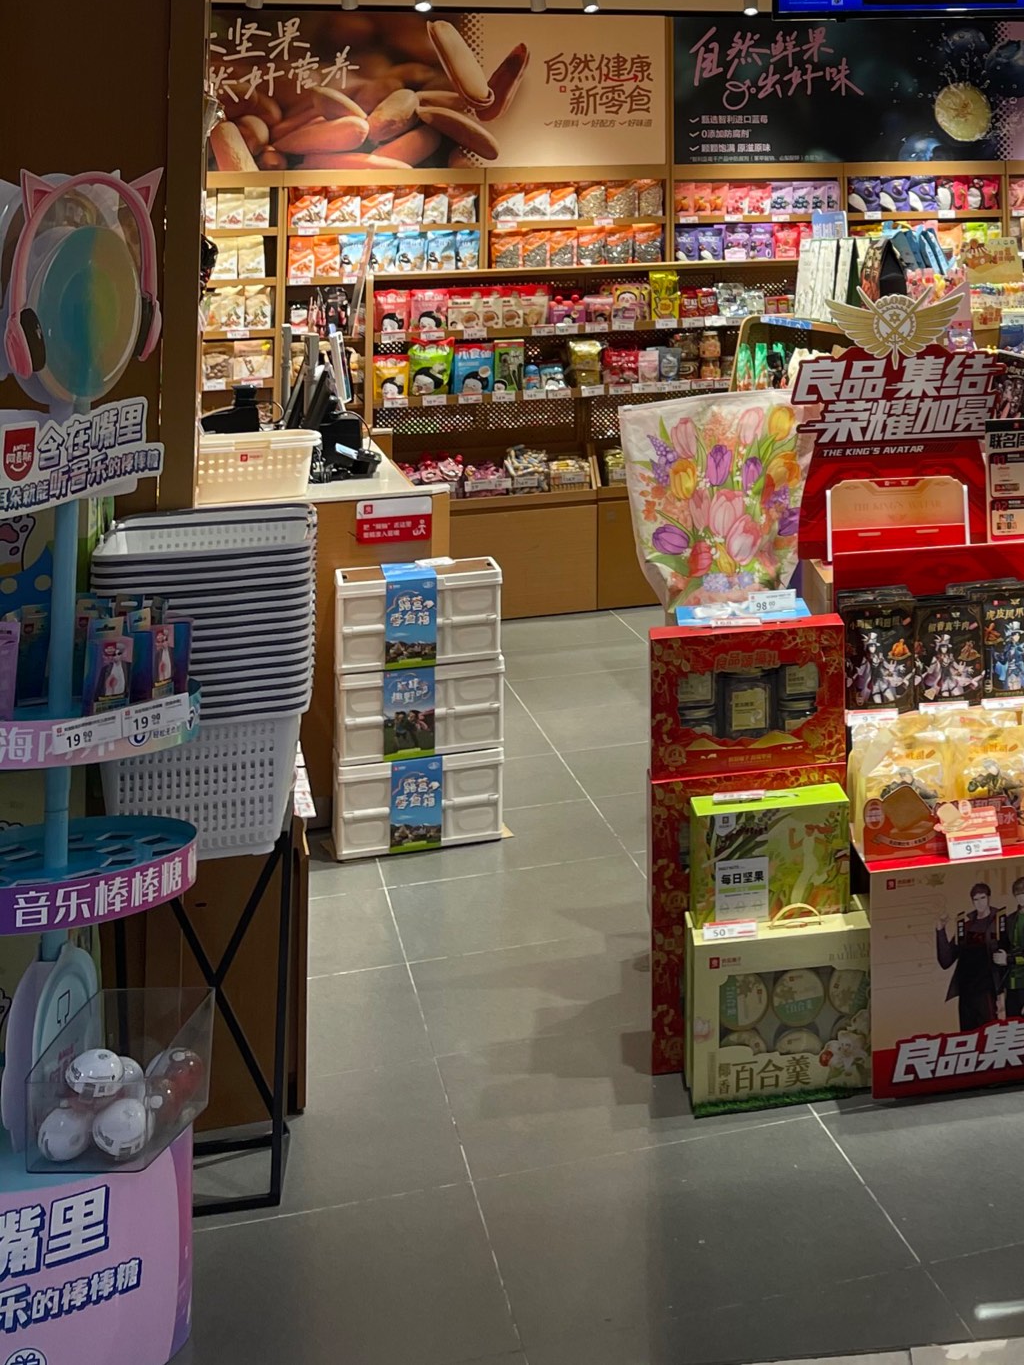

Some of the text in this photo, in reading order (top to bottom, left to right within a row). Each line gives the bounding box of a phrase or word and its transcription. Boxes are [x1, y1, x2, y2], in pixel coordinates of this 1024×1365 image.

[543, 53, 653, 84] 自然健康
[689, 26, 834, 87] 自然鲜果
[569, 84, 653, 116] 新零食
[591, 119, 617, 128] 好配方
[793, 355, 996, 402] 良品集结
[800, 395, 996, 443] 荣耀加冕
[38, 403, 144, 470] 含在嘴里
[823, 445, 924, 457] THE KING'S AVATAR
[756, 601, 767, 611] 98
[133, 716, 148, 730] 19
[66, 733, 81, 748] 19
[13, 857, 183, 928] 音乐棒棒糖
[721, 870, 764, 885] 每日坚果
[732, 1056, 812, 1093] 百合羹
